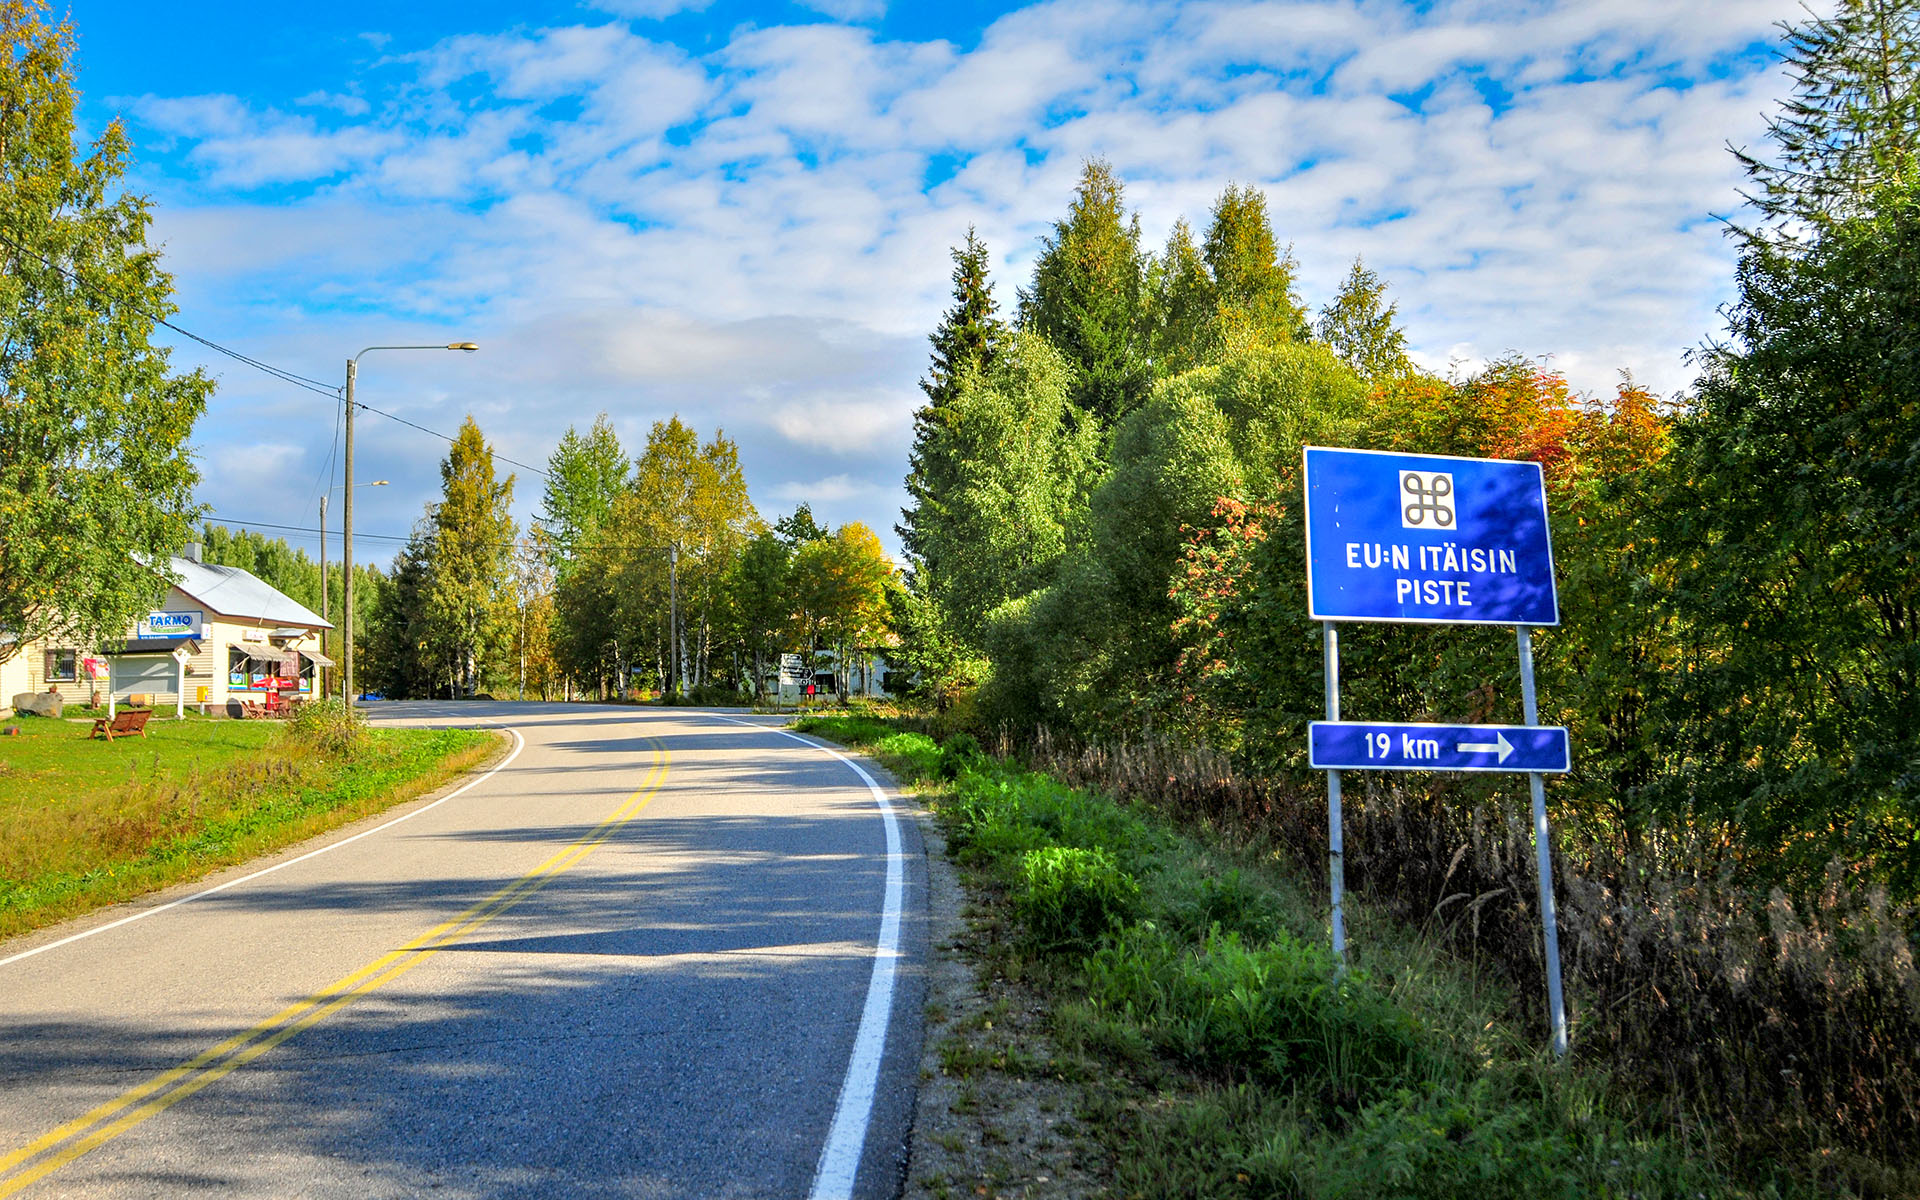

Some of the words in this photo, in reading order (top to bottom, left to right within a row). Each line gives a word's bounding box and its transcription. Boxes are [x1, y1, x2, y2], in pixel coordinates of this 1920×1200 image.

[1346, 543, 1409, 570] EU:N
[1420, 542, 1516, 573] ITÄISIN
[1396, 579, 1472, 606] PISTE
[149, 615, 192, 626] TARMO
[1365, 733, 1391, 758] 19
[1402, 734, 1439, 759] km
